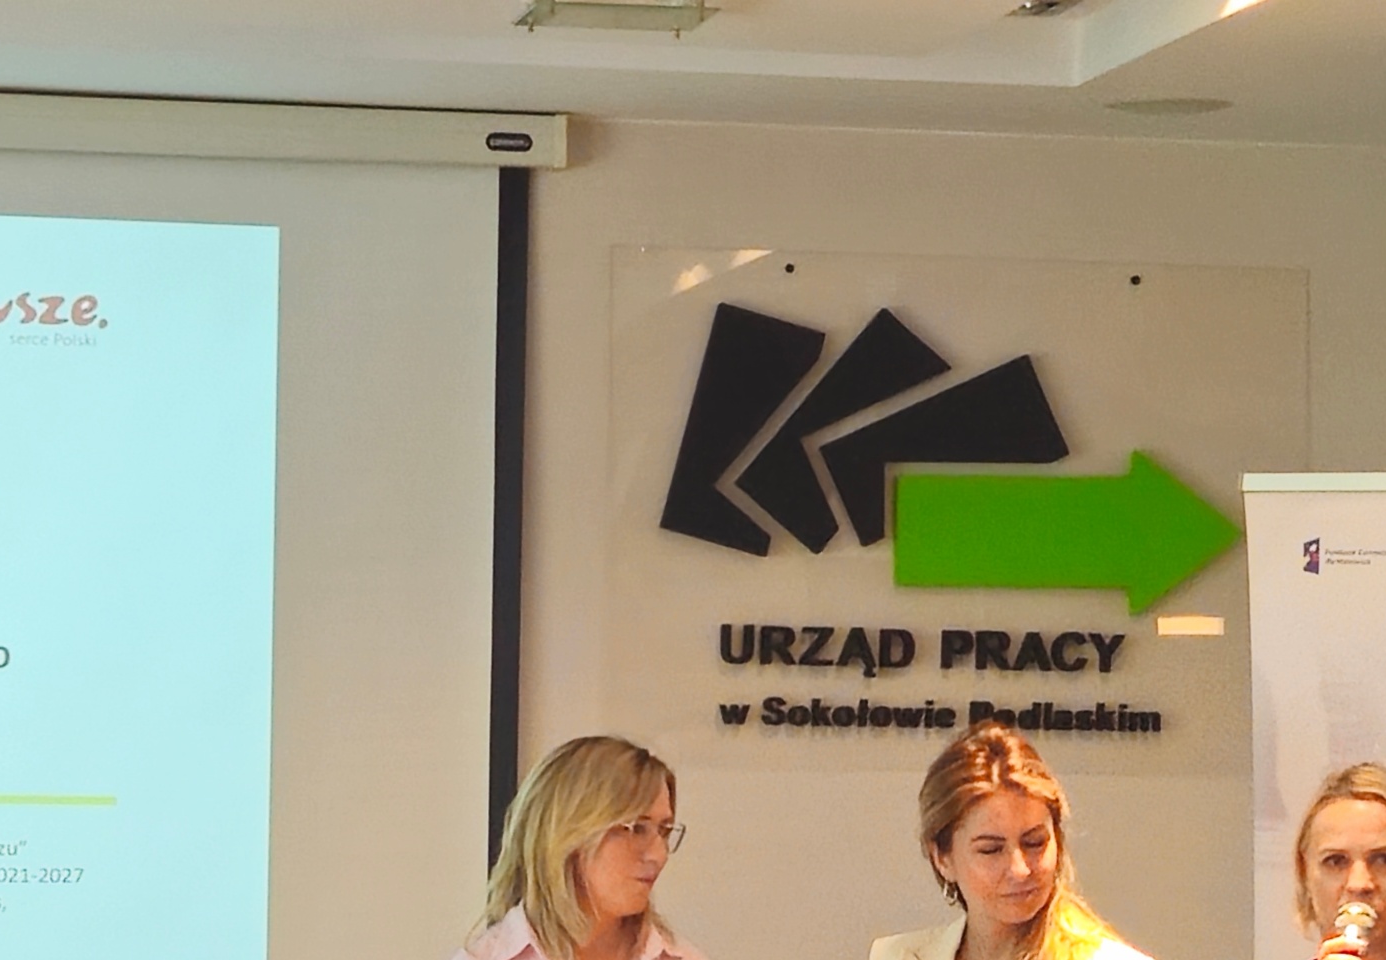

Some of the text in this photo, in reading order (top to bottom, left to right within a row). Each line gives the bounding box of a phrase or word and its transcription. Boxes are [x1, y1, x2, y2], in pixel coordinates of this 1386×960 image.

[9, 332, 97, 347] serce Polski
[719, 624, 1126, 678] URZĄD PRACY
[719, 703, 751, 726] w
[761, 697, 956, 729] Sokołowie
